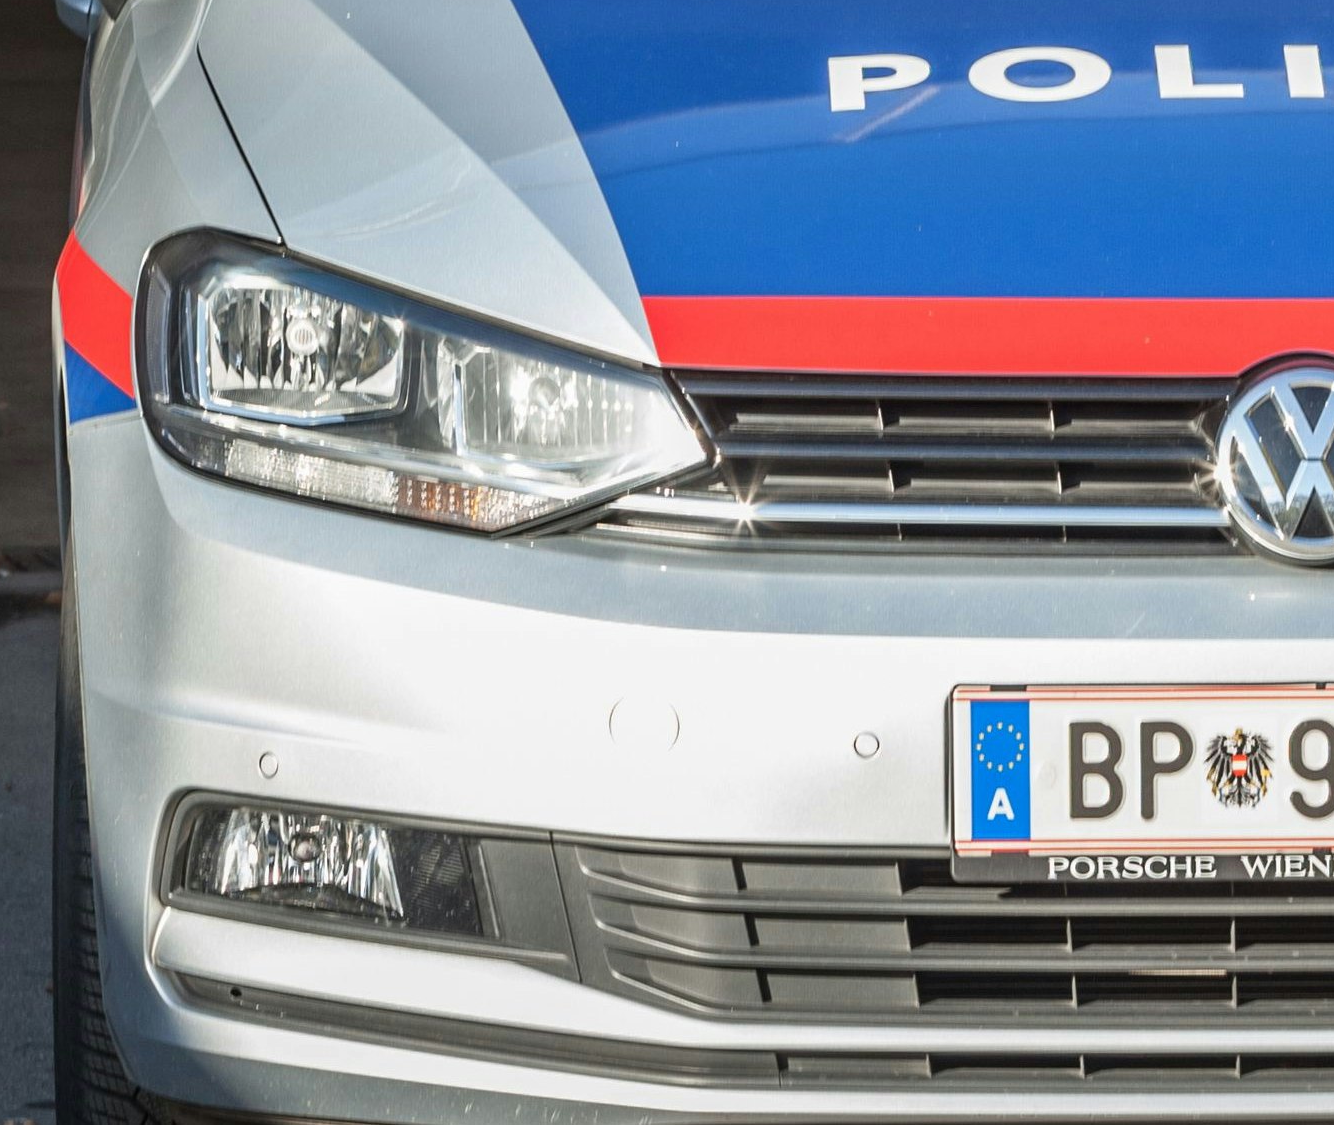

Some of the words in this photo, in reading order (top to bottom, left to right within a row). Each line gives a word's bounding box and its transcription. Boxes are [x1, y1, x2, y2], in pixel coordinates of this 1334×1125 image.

[1068, 719, 1195, 821] BP
[986, 787, 1016, 821] A
[1046, 854, 1218, 881] PORSCHE
